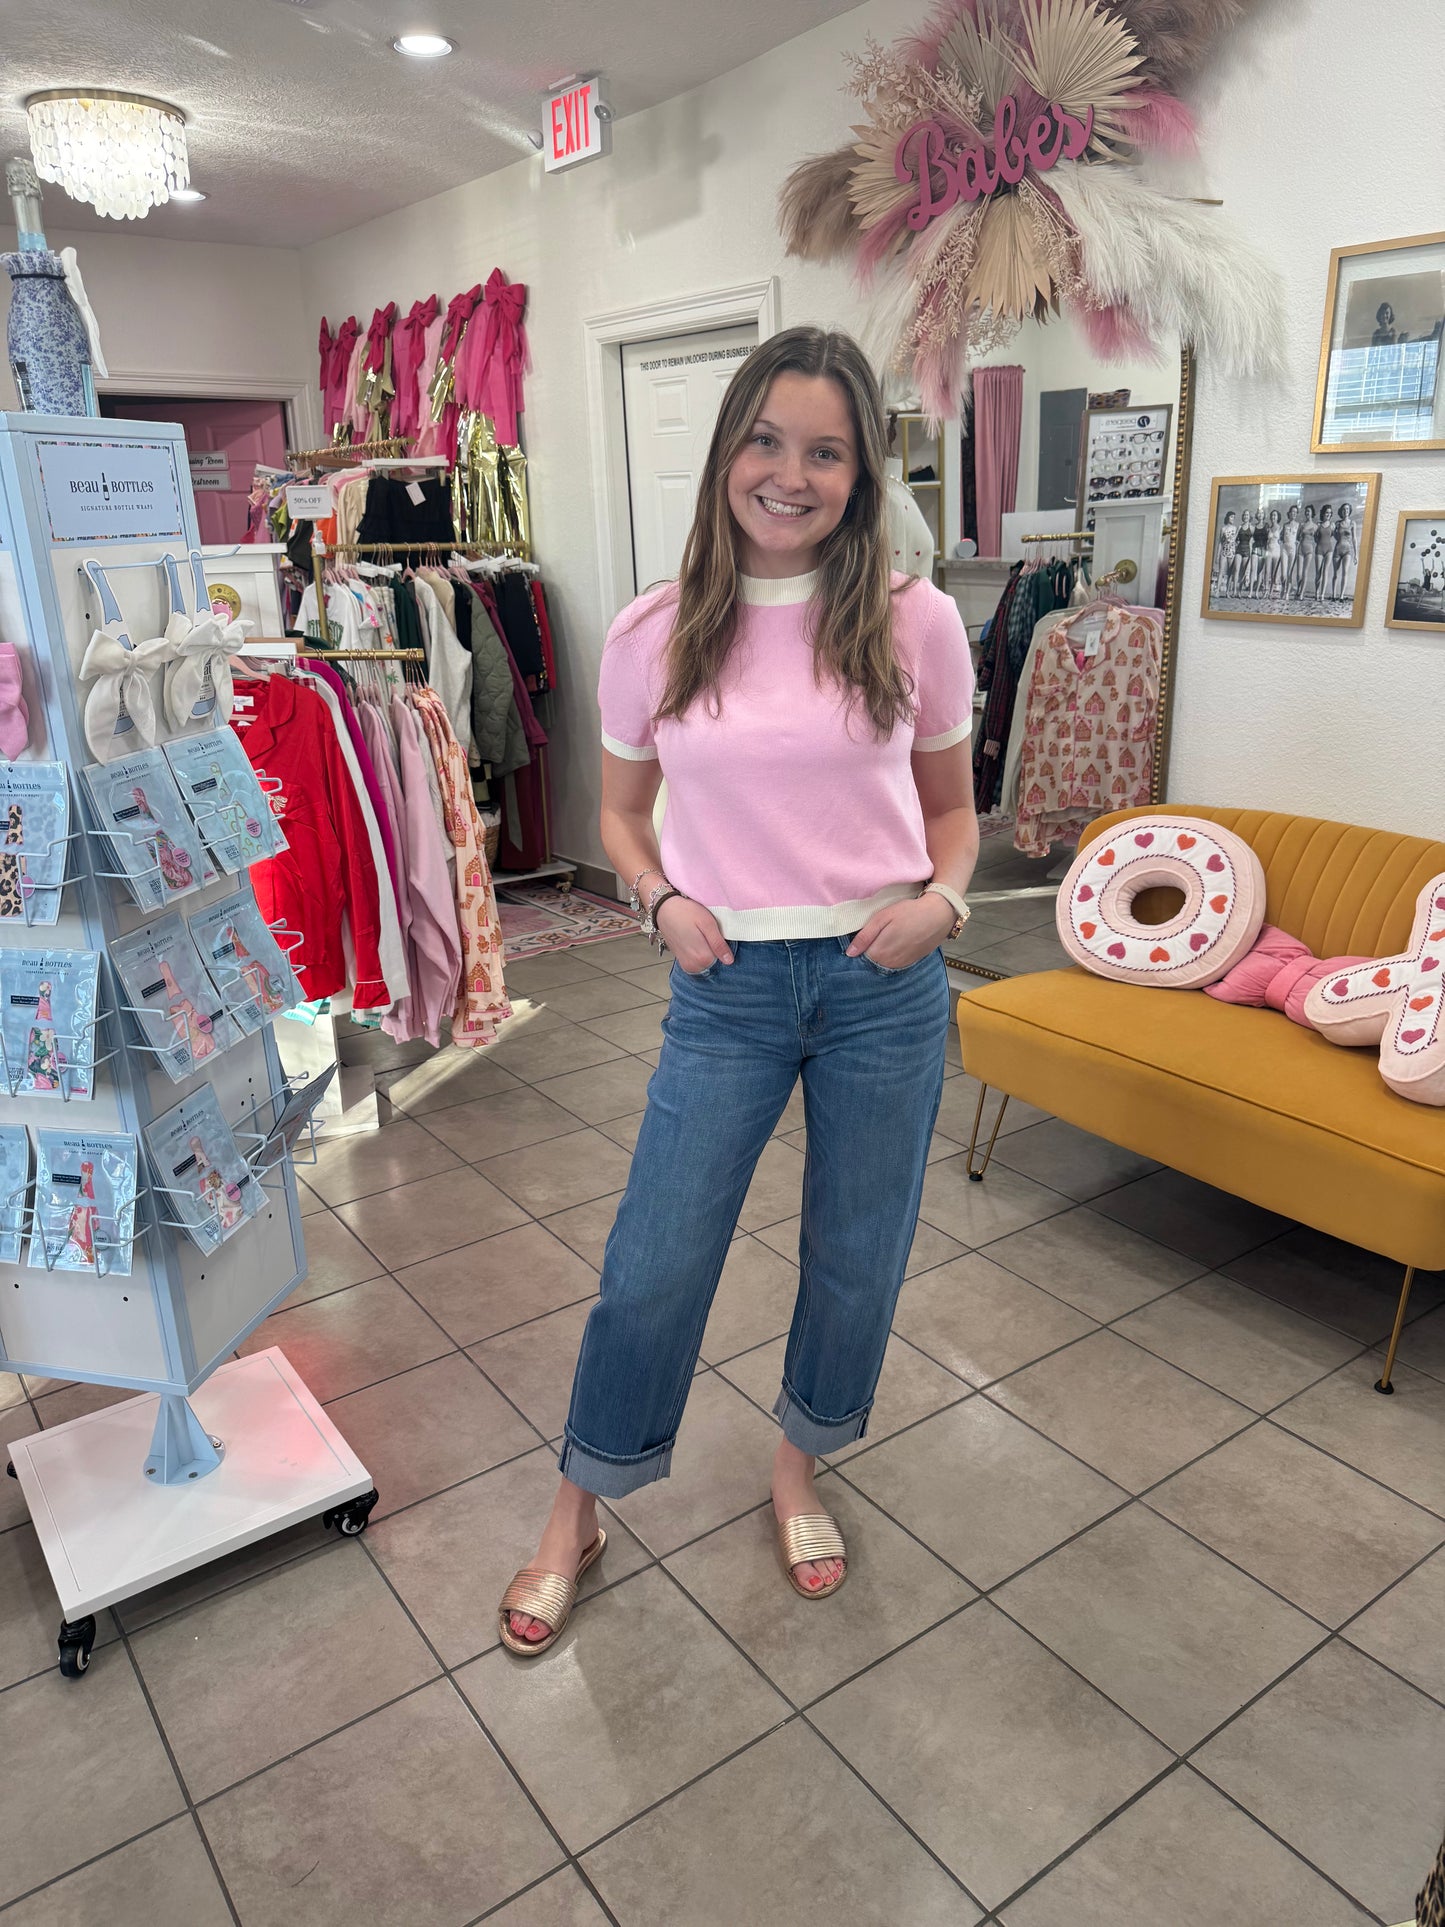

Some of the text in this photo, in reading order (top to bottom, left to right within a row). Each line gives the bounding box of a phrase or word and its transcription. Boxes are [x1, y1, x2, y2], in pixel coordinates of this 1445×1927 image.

[551, 85, 591, 160] EXIT
[894, 95, 1094, 231] Babes
[640, 362, 649, 371] THIS
[649, 360, 661, 370] DOOR
[661, 359, 668, 368] TO
[668, 357, 684, 367] REMAIN
[684, 353, 708, 365] UNLOCKED
[708, 350, 725, 361] DURING
[726, 346, 749, 359] BUSINESS
[205, 456, 224, 465] Room
